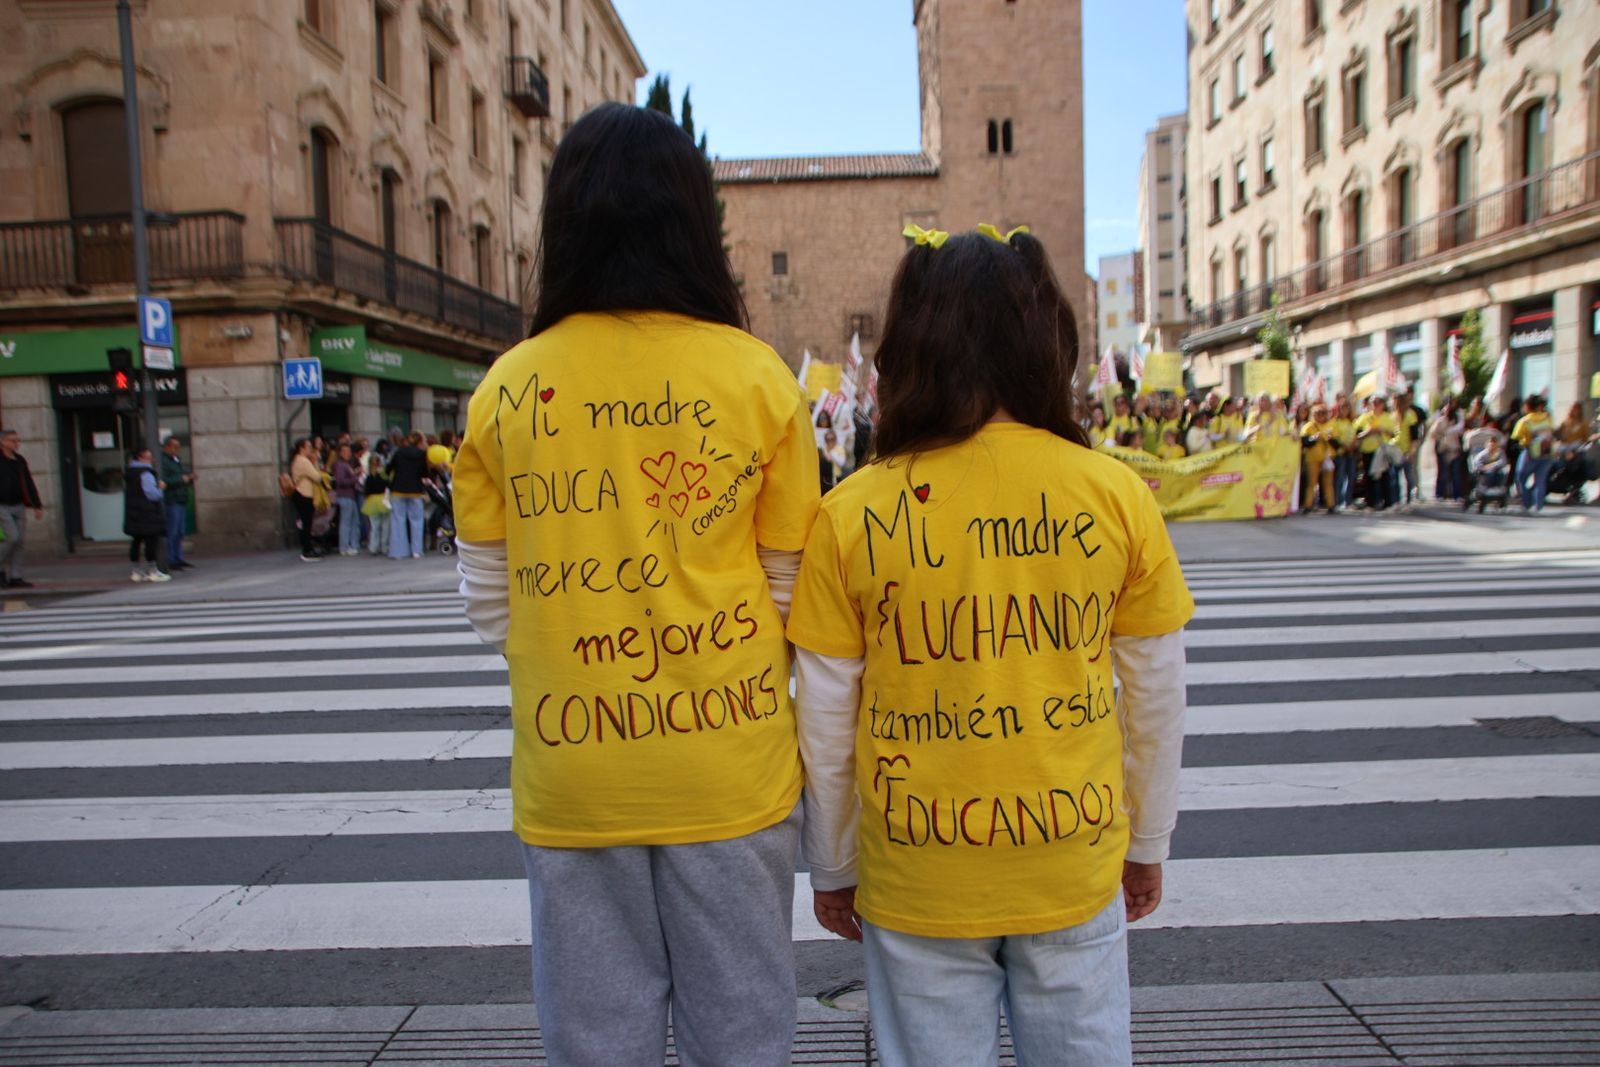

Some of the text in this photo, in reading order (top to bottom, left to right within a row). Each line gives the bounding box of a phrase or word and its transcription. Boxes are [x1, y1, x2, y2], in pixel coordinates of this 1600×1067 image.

[144, 300, 167, 340] P
[320, 337, 355, 351] DKV
[495, 373, 717, 448] Mi madre
[510, 468, 620, 519] EDUCA
[864, 483, 1102, 577] Mi madre
[516, 553, 669, 598] merece
[573, 600, 758, 682] mejores
[535, 663, 779, 747] CONDICIONES
[869, 674, 1112, 744] también está
